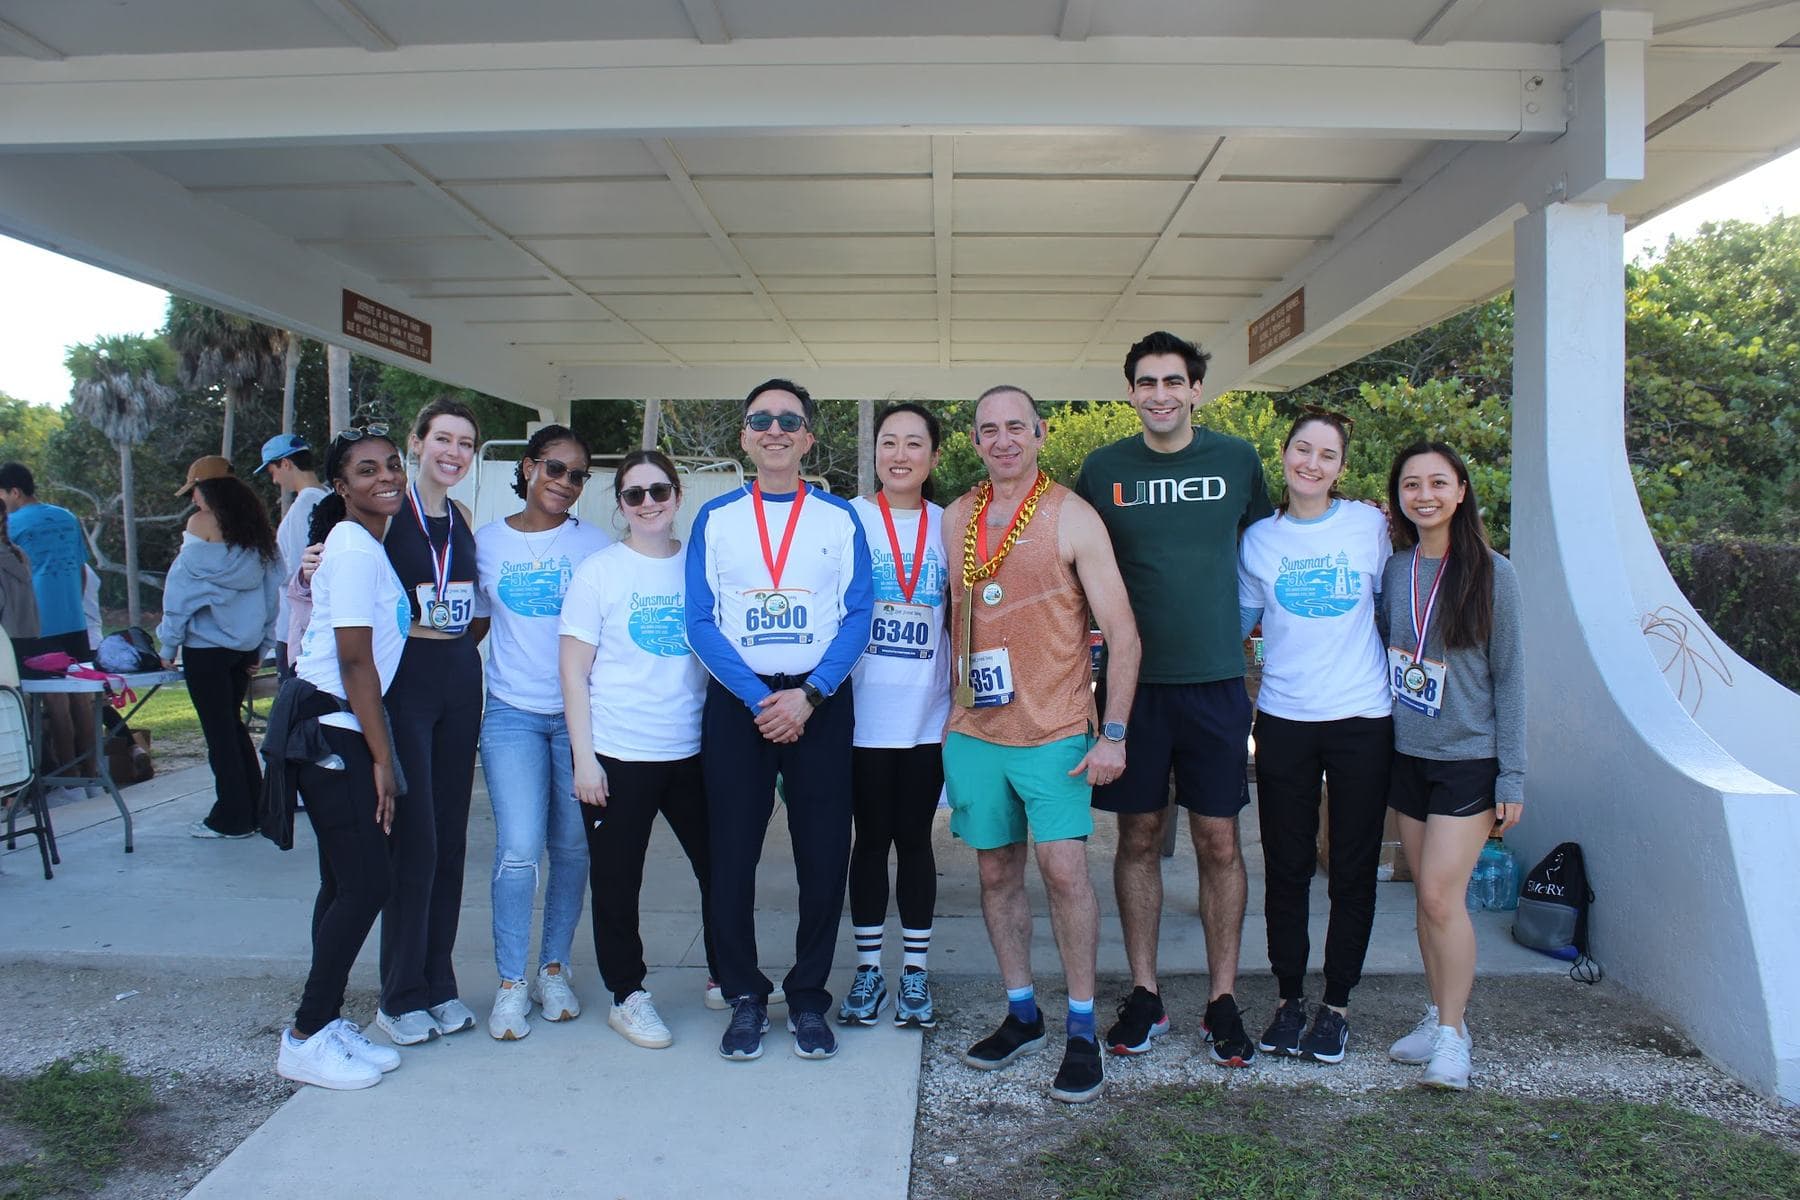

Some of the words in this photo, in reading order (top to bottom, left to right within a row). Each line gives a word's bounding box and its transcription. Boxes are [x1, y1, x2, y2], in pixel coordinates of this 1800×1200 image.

[1113, 476, 1226, 507] UMED
[1278, 553, 1333, 573] Sunsmart
[511, 572, 529, 586] 5K
[1288, 570, 1306, 586] 5K
[630, 591, 684, 611] Sunsmart
[641, 607, 659, 624] 5K
[872, 618, 928, 645] 6340
[1394, 666, 1437, 702] 68
